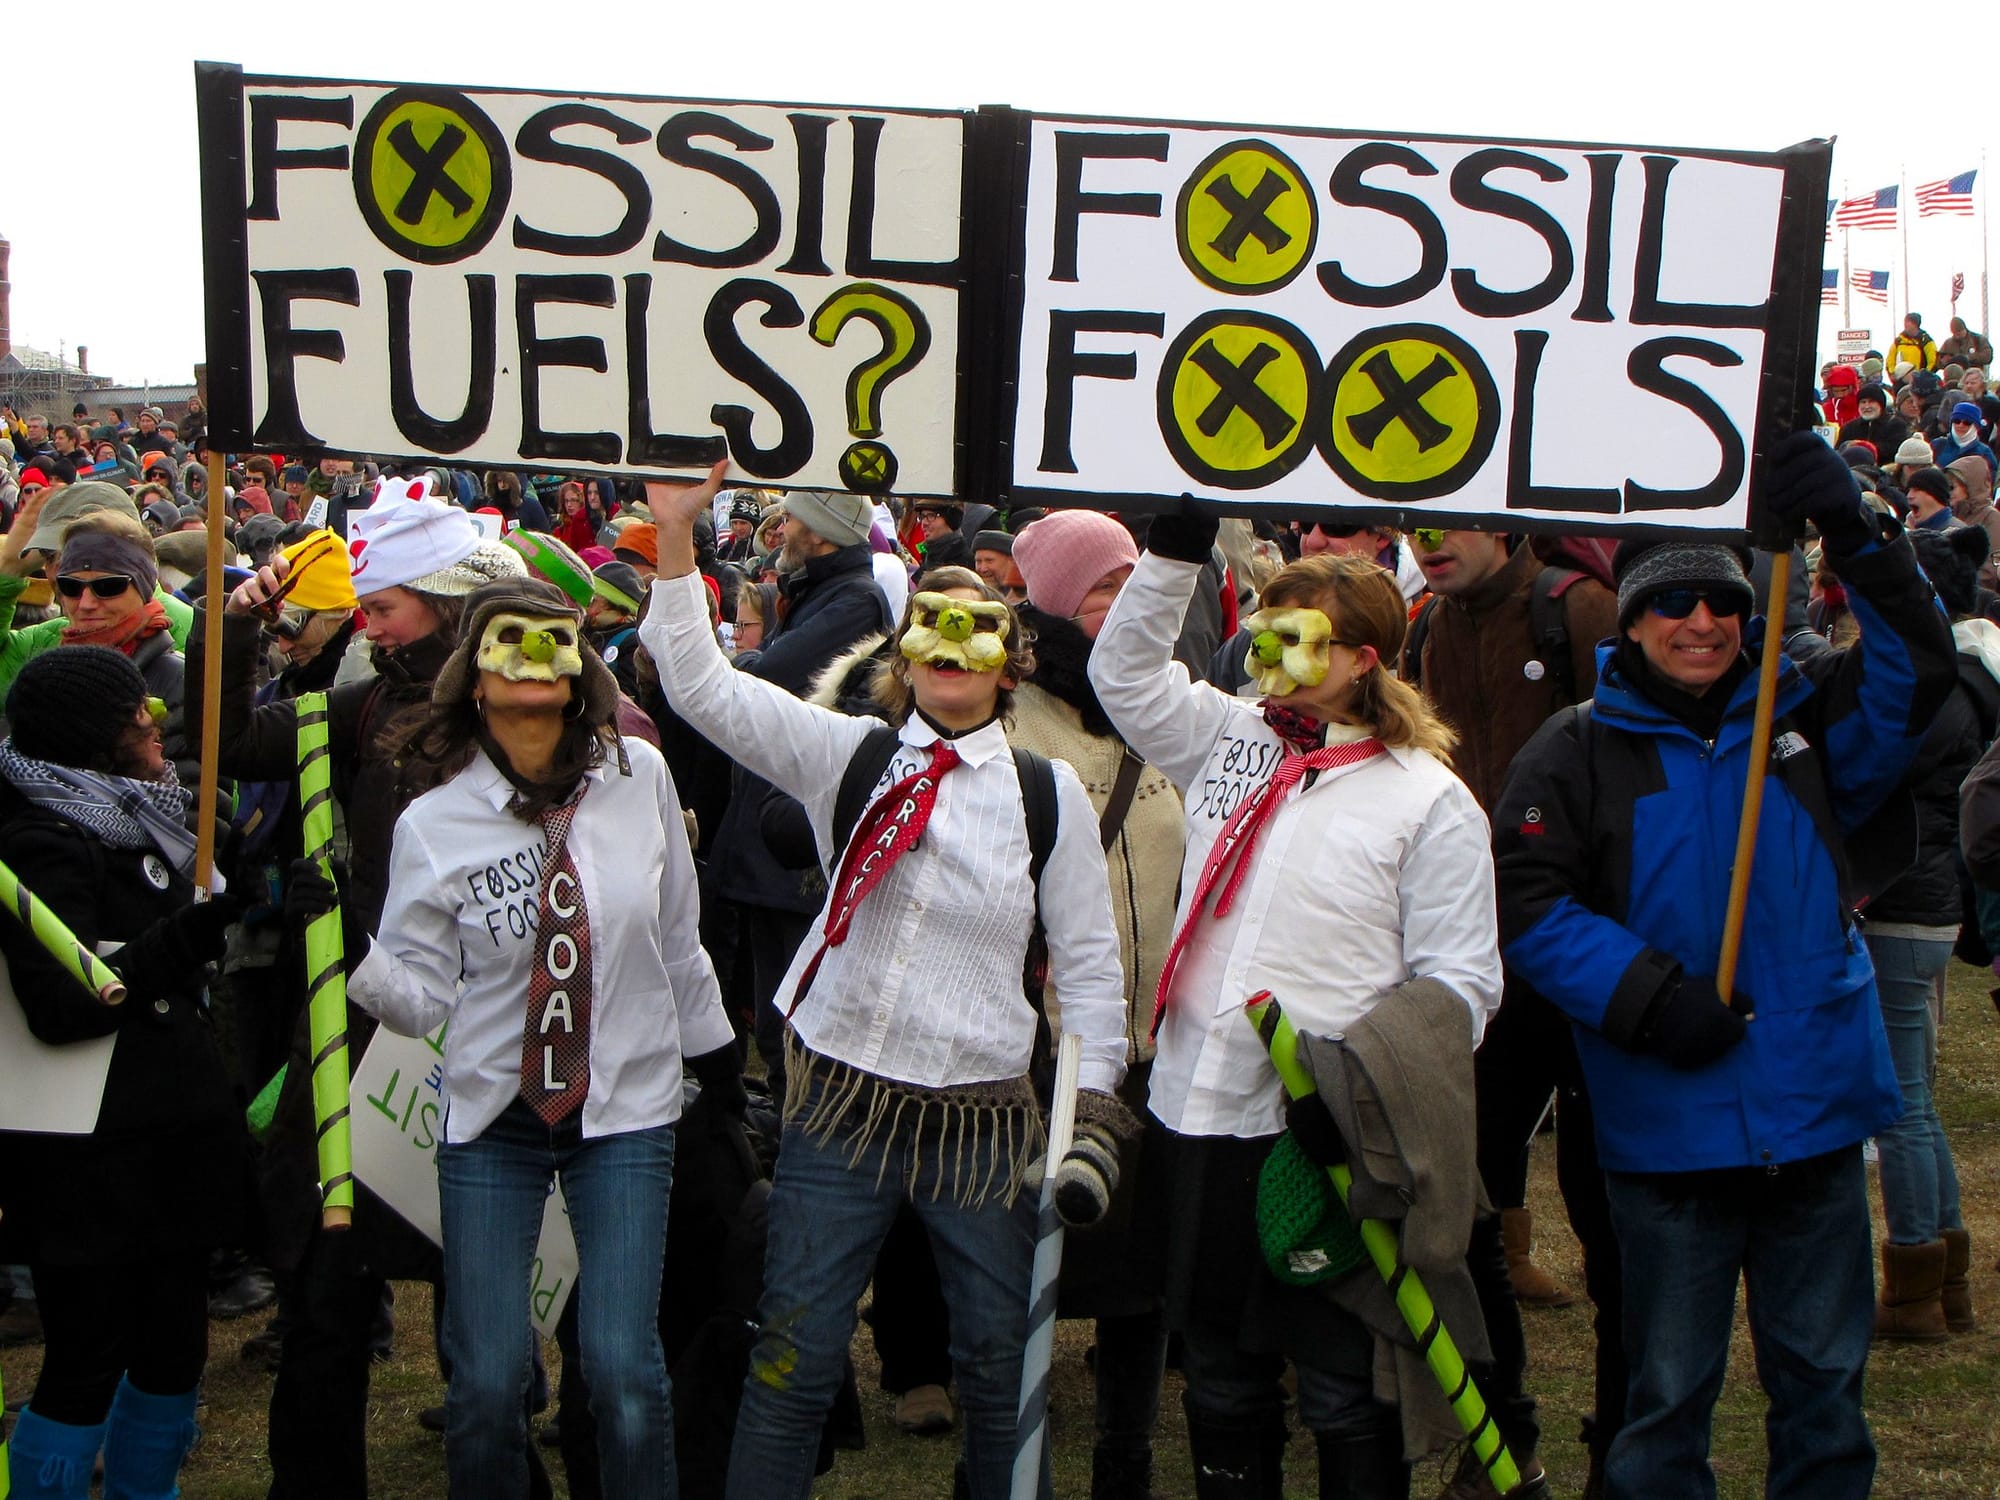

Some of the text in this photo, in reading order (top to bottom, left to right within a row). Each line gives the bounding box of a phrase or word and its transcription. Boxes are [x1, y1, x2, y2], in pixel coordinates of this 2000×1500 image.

[247, 87, 960, 282] FOSSIL
[1048, 132, 1768, 329] FOSSIL
[251, 266, 932, 492] FUELS?
[1037, 309, 1745, 512] FOOLS
[308, 502, 323, 525] ARD
[539, 870, 580, 1091] COAL
